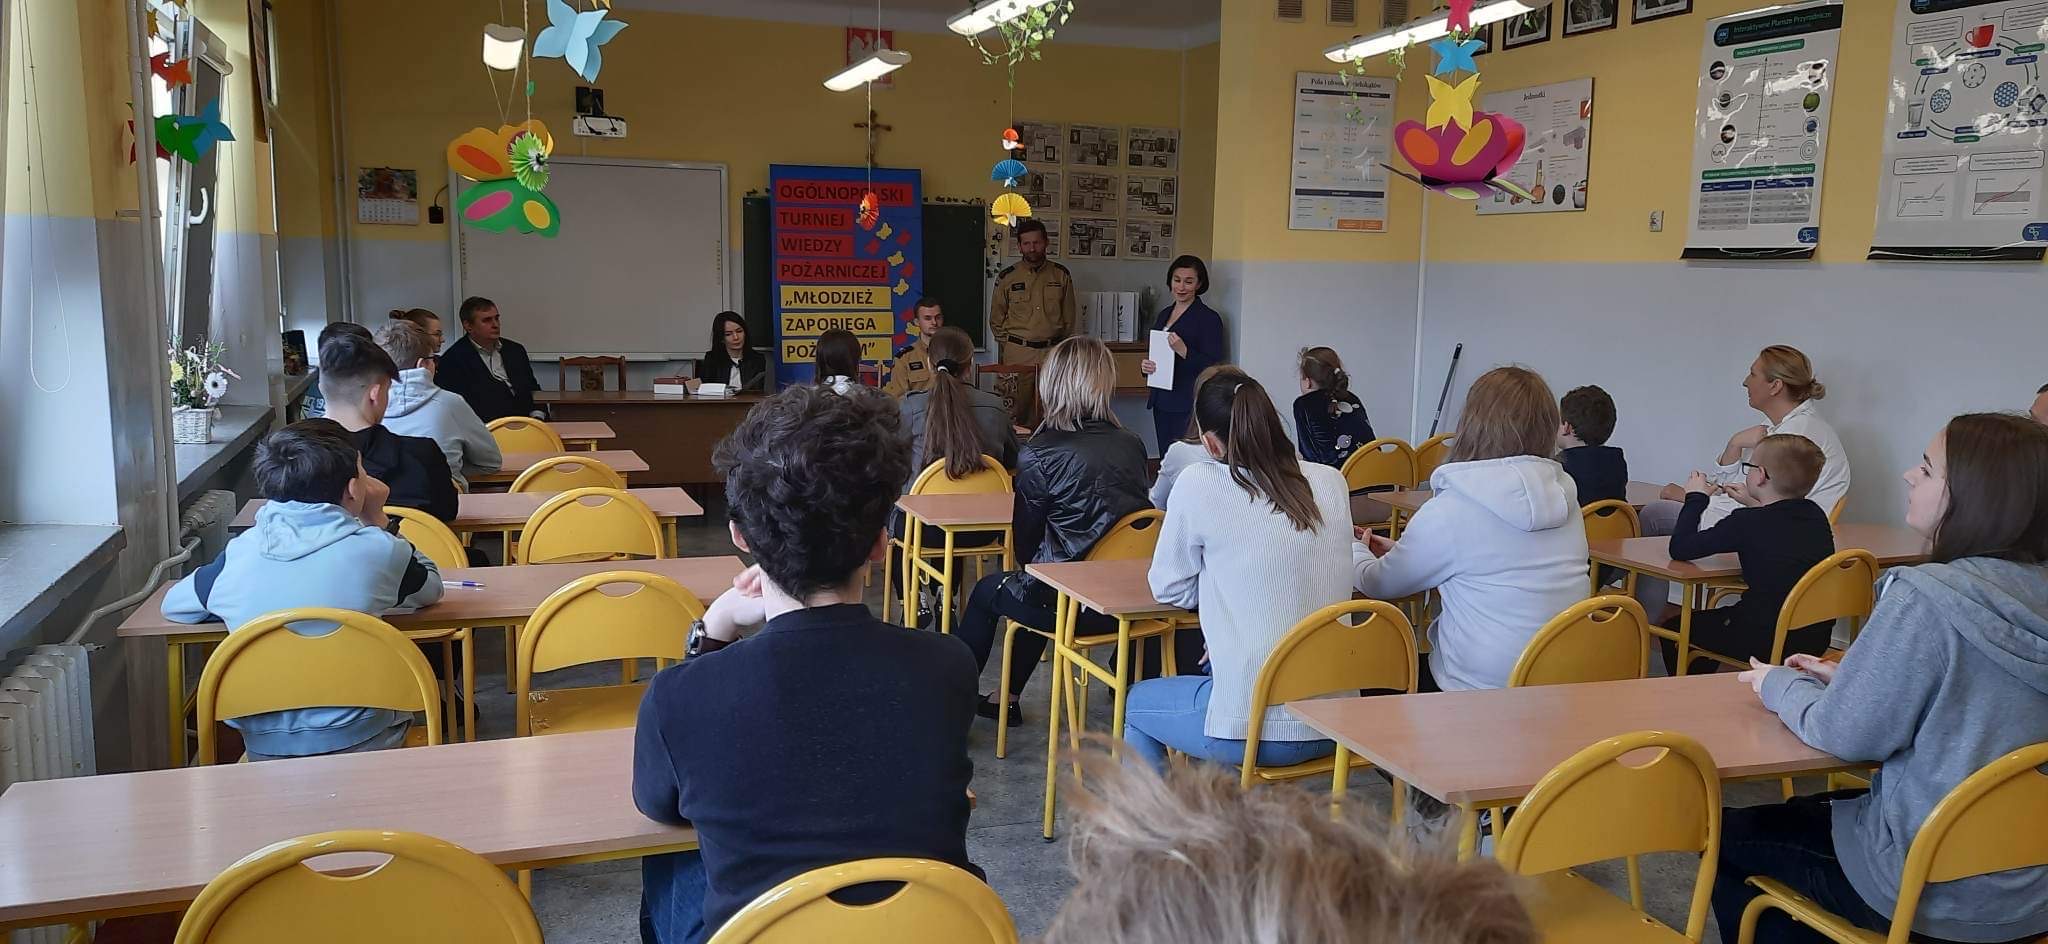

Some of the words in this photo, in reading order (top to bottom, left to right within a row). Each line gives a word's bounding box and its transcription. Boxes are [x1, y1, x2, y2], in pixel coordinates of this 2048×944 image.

[780, 212, 844, 227] TURNIEJ
[781, 238, 842, 252] WIEDZY
[781, 262, 886, 278] POŻARNICZEJ
[786, 318, 876, 331] ZAPOBIEGA
